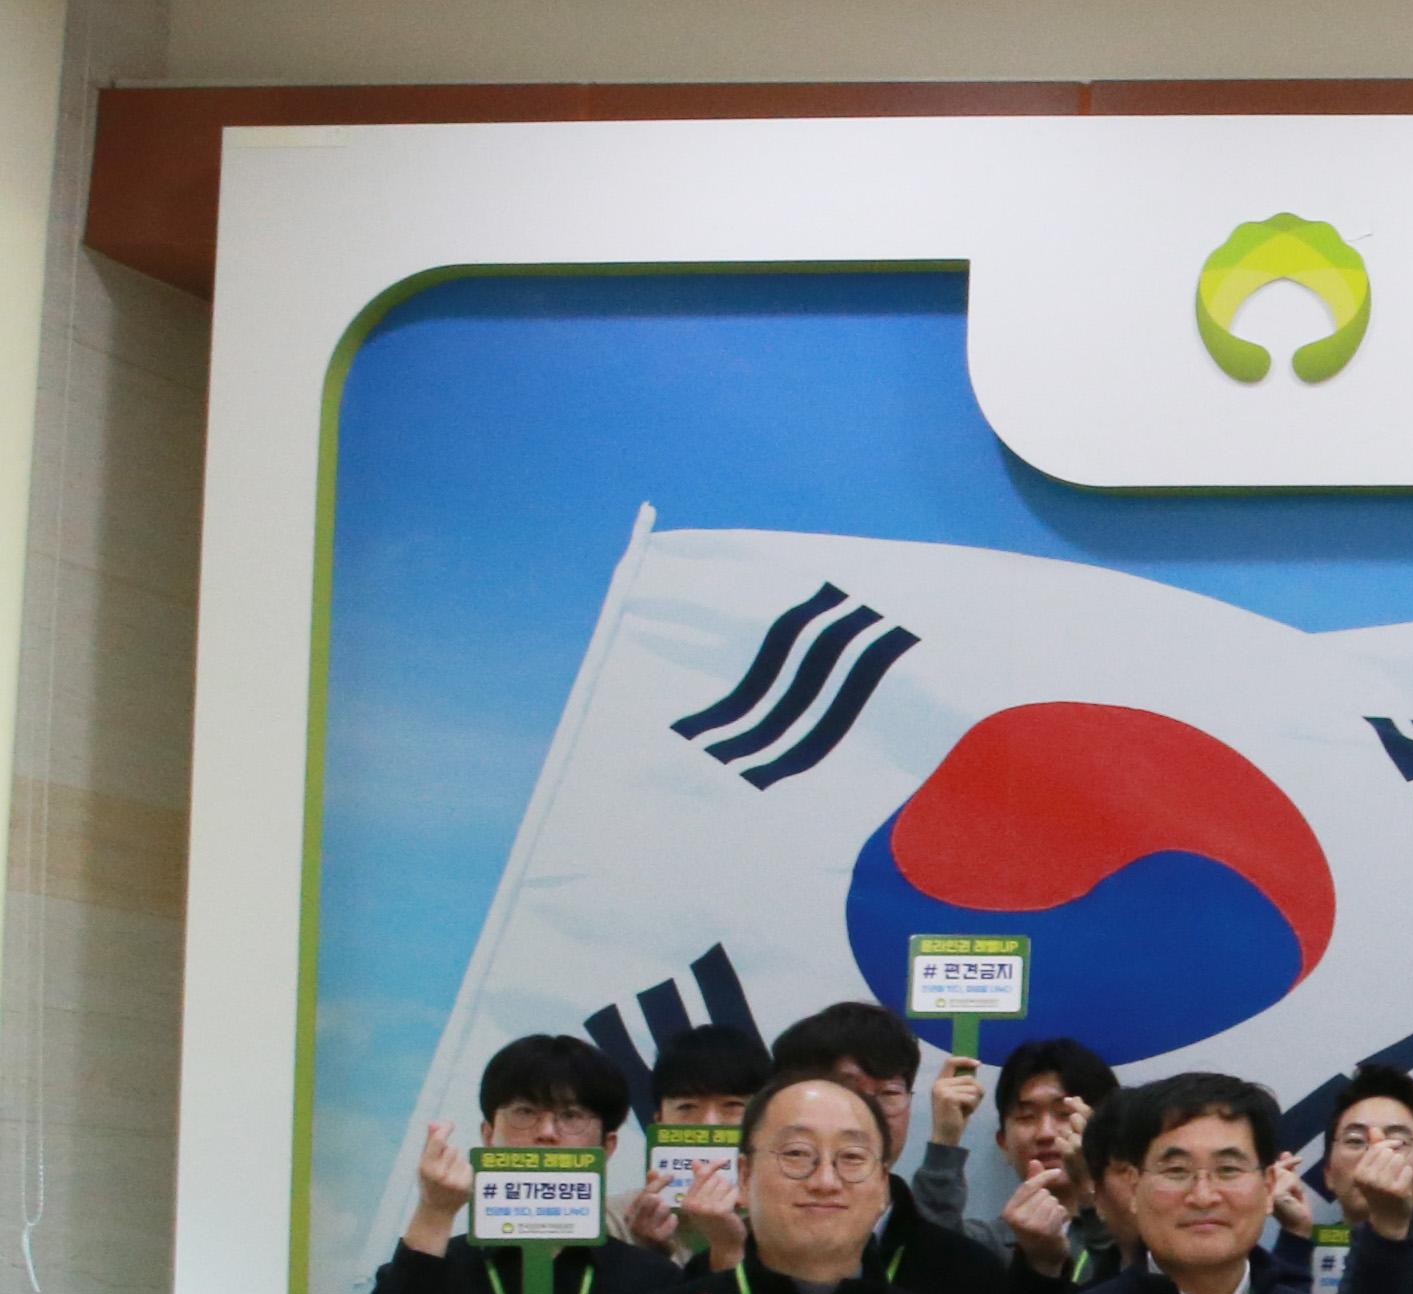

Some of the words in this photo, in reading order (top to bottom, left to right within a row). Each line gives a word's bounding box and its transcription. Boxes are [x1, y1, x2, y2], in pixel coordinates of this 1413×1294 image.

[923, 964, 938, 979] #
[944, 963, 1013, 980] 편견금지
[483, 1183, 497, 1198] #
[505, 1183, 592, 1200] 일가정양립
